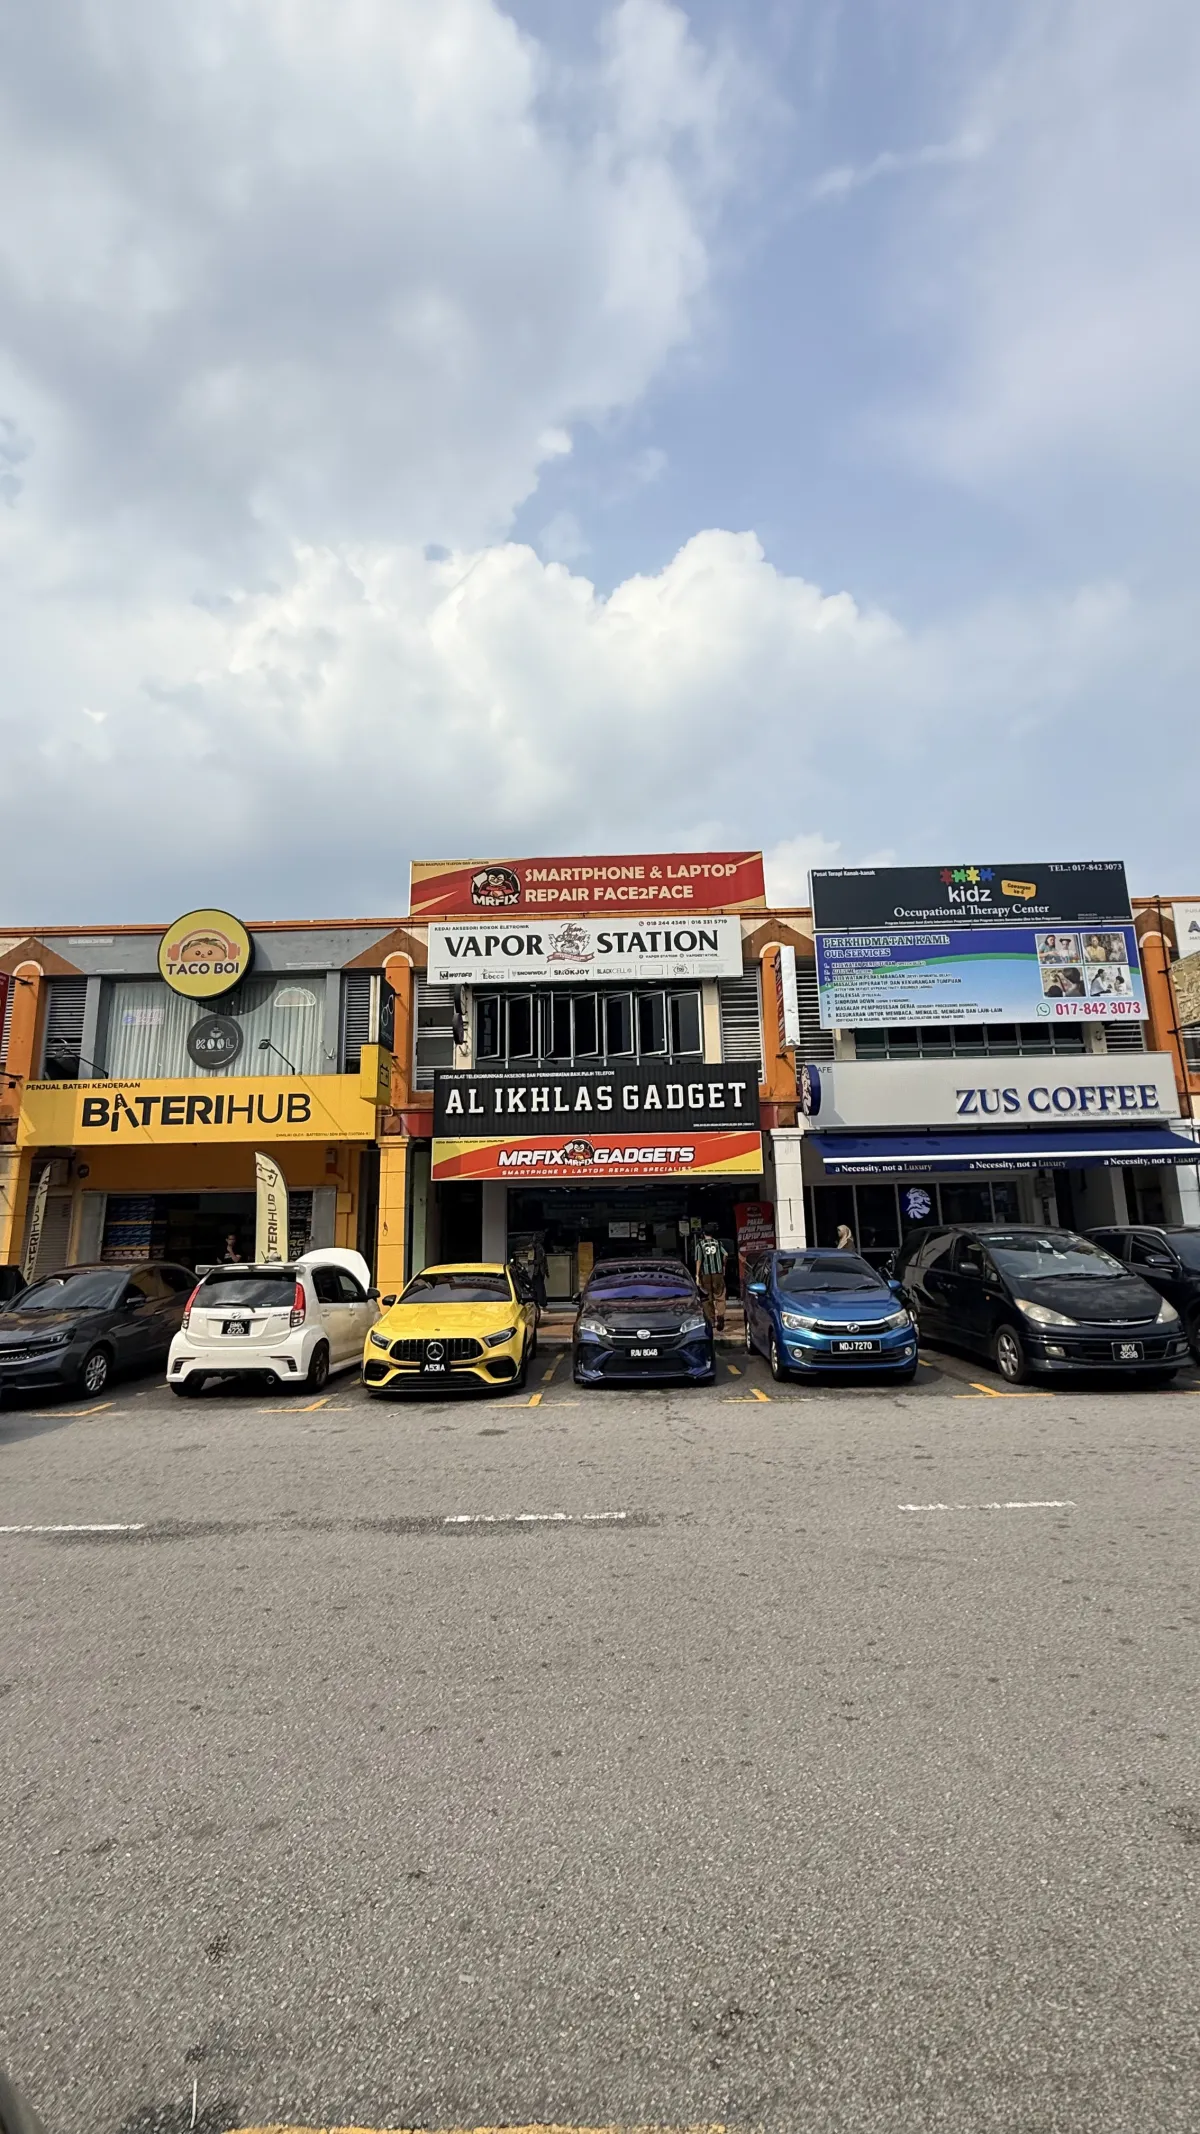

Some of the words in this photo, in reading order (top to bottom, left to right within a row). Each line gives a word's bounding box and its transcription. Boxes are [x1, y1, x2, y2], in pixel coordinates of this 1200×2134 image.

[525, 866, 645, 882] SMARTPHONE
[650, 866, 662, 879] &
[667, 864, 737, 878] LAPTOP
[473, 893, 520, 906] MRFIX
[525, 888, 589, 902] REPAIR
[594, 886, 693, 900] FACE2FACE
[948, 886, 992, 902] kidz
[894, 906, 966, 919] Occupational
[967, 905, 1010, 917] Therapy
[1012, 904, 1049, 914] Center
[445, 935, 545, 957] VAPOR
[597, 930, 718, 953] STATION
[823, 936, 913, 948] PERKHIDMATAN
[824, 950, 844, 958] OUR
[845, 948, 891, 957] SERVICES
[166, 963, 210, 975] TACO
[214, 963, 239, 974] BOI
[1056, 1003, 1107, 1015] 017-842
[1110, 1002, 1141, 1014] 3073
[446, 1088, 484, 1114] AL
[494, 1085, 612, 1113] IKHLAS
[623, 1083, 746, 1110] GADGET
[956, 1088, 1021, 1114] ZUS
[1028, 1084, 1159, 1112] COFFEE
[81, 1093, 311, 1132] BATERIHUB
[499, 1150, 565, 1166] MRFIX
[565, 1158, 594, 1166] MRFIX
[594, 1147, 694, 1163] GADGETS
[842, 1164, 881, 1173] Necessity,
[904, 1163, 932, 1171] Luxury
[976, 1161, 1016, 1170] Necessity,
[1038, 1160, 1066, 1168] Luxury
[1110, 1158, 1150, 1167] Necessity,
[268, 1194, 277, 1253] TERIHUB
[705, 1246, 716, 1255] 39
[854, 1341, 872, 1350] 7270
